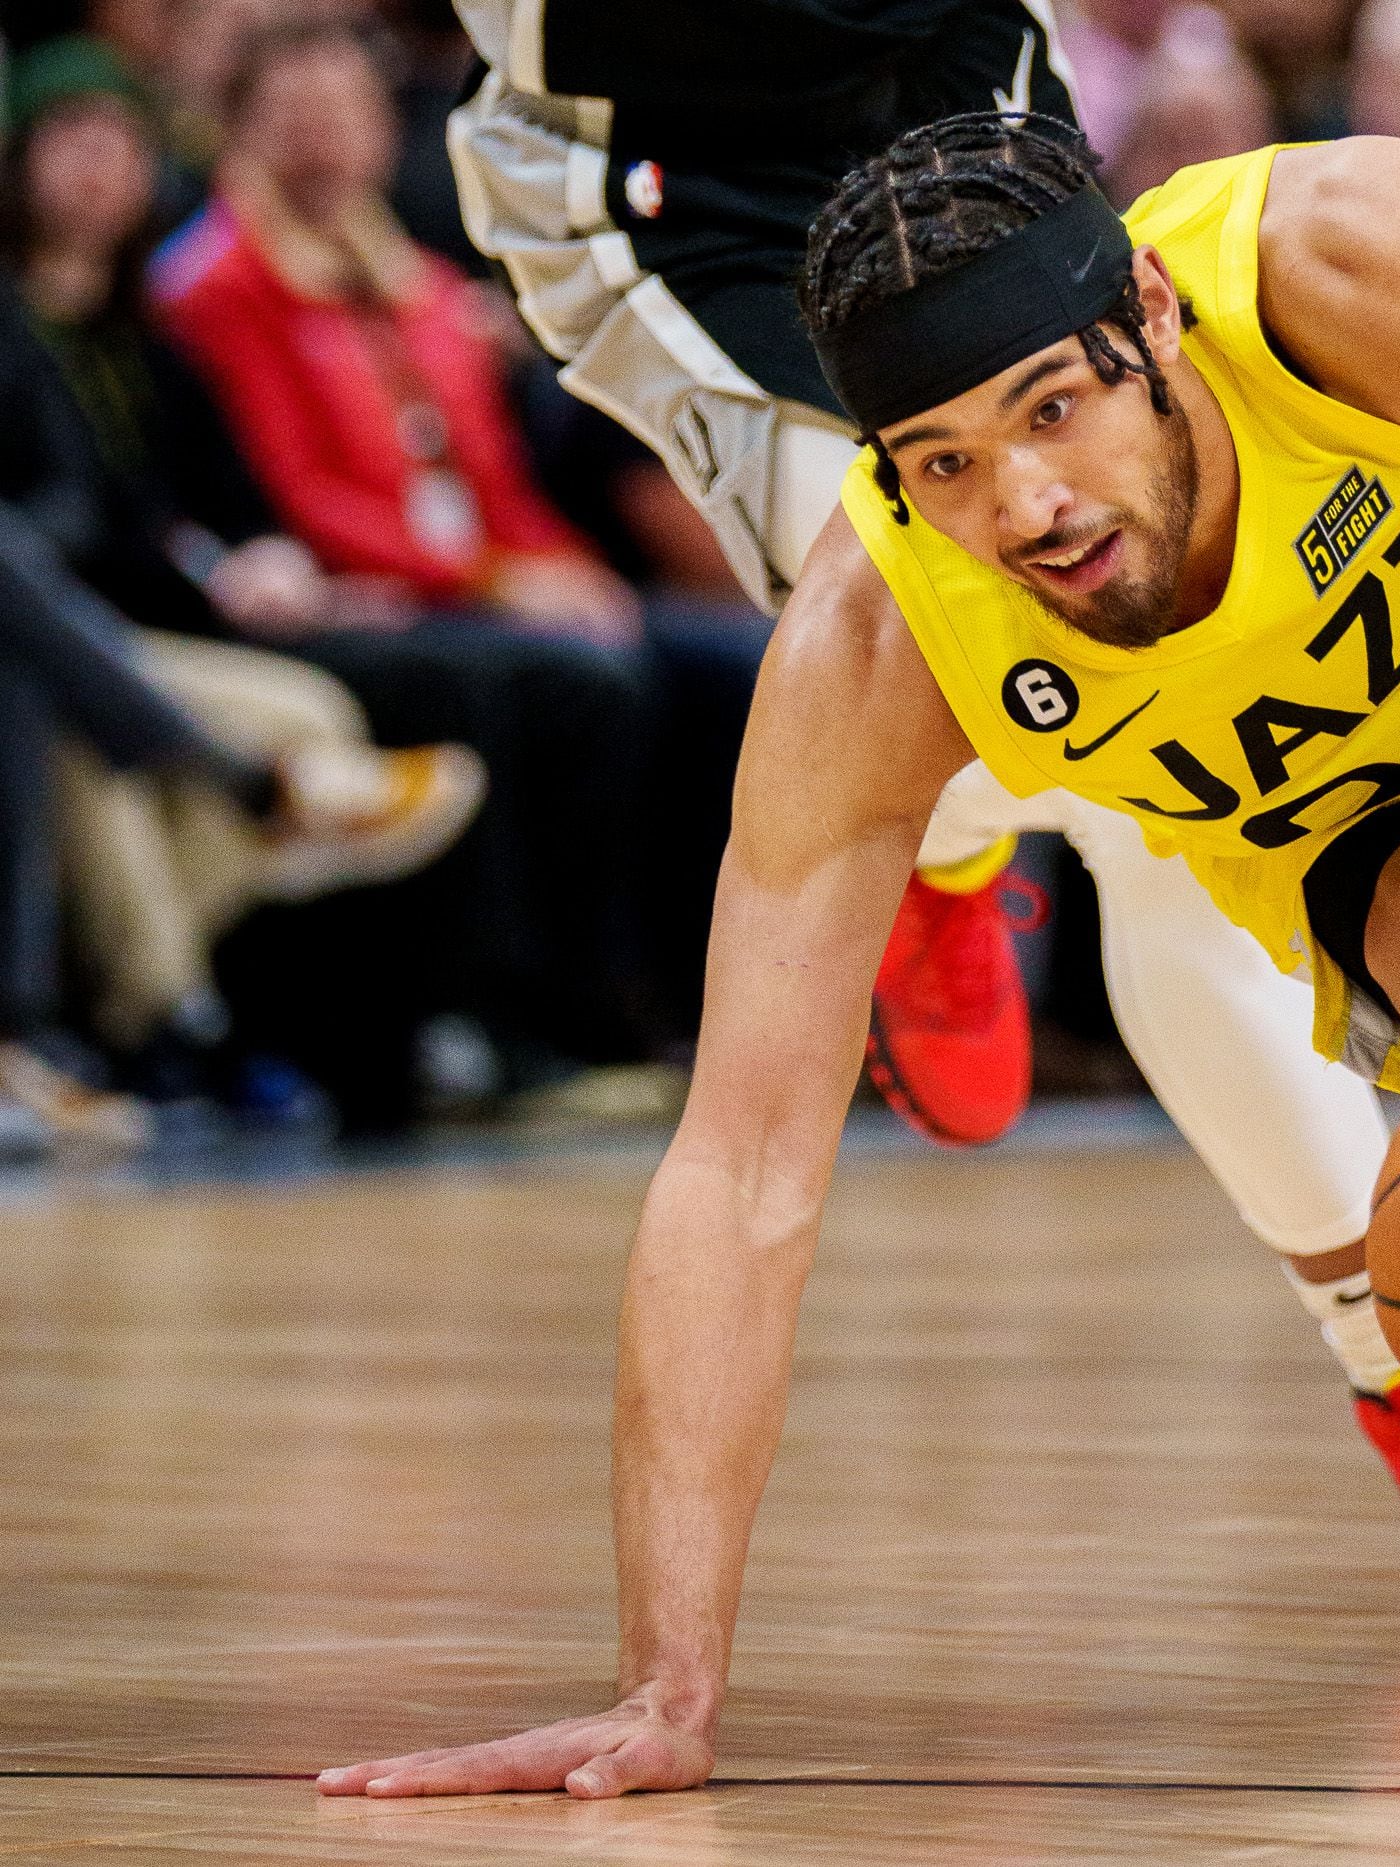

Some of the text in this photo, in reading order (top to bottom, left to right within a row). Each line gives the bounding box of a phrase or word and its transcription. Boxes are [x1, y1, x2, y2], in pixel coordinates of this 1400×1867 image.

[1323, 475, 1361, 526] FOR THE
[1335, 488, 1385, 558] FIGHT
[1301, 528, 1335, 585] 5
[1014, 667, 1069, 726] 6
